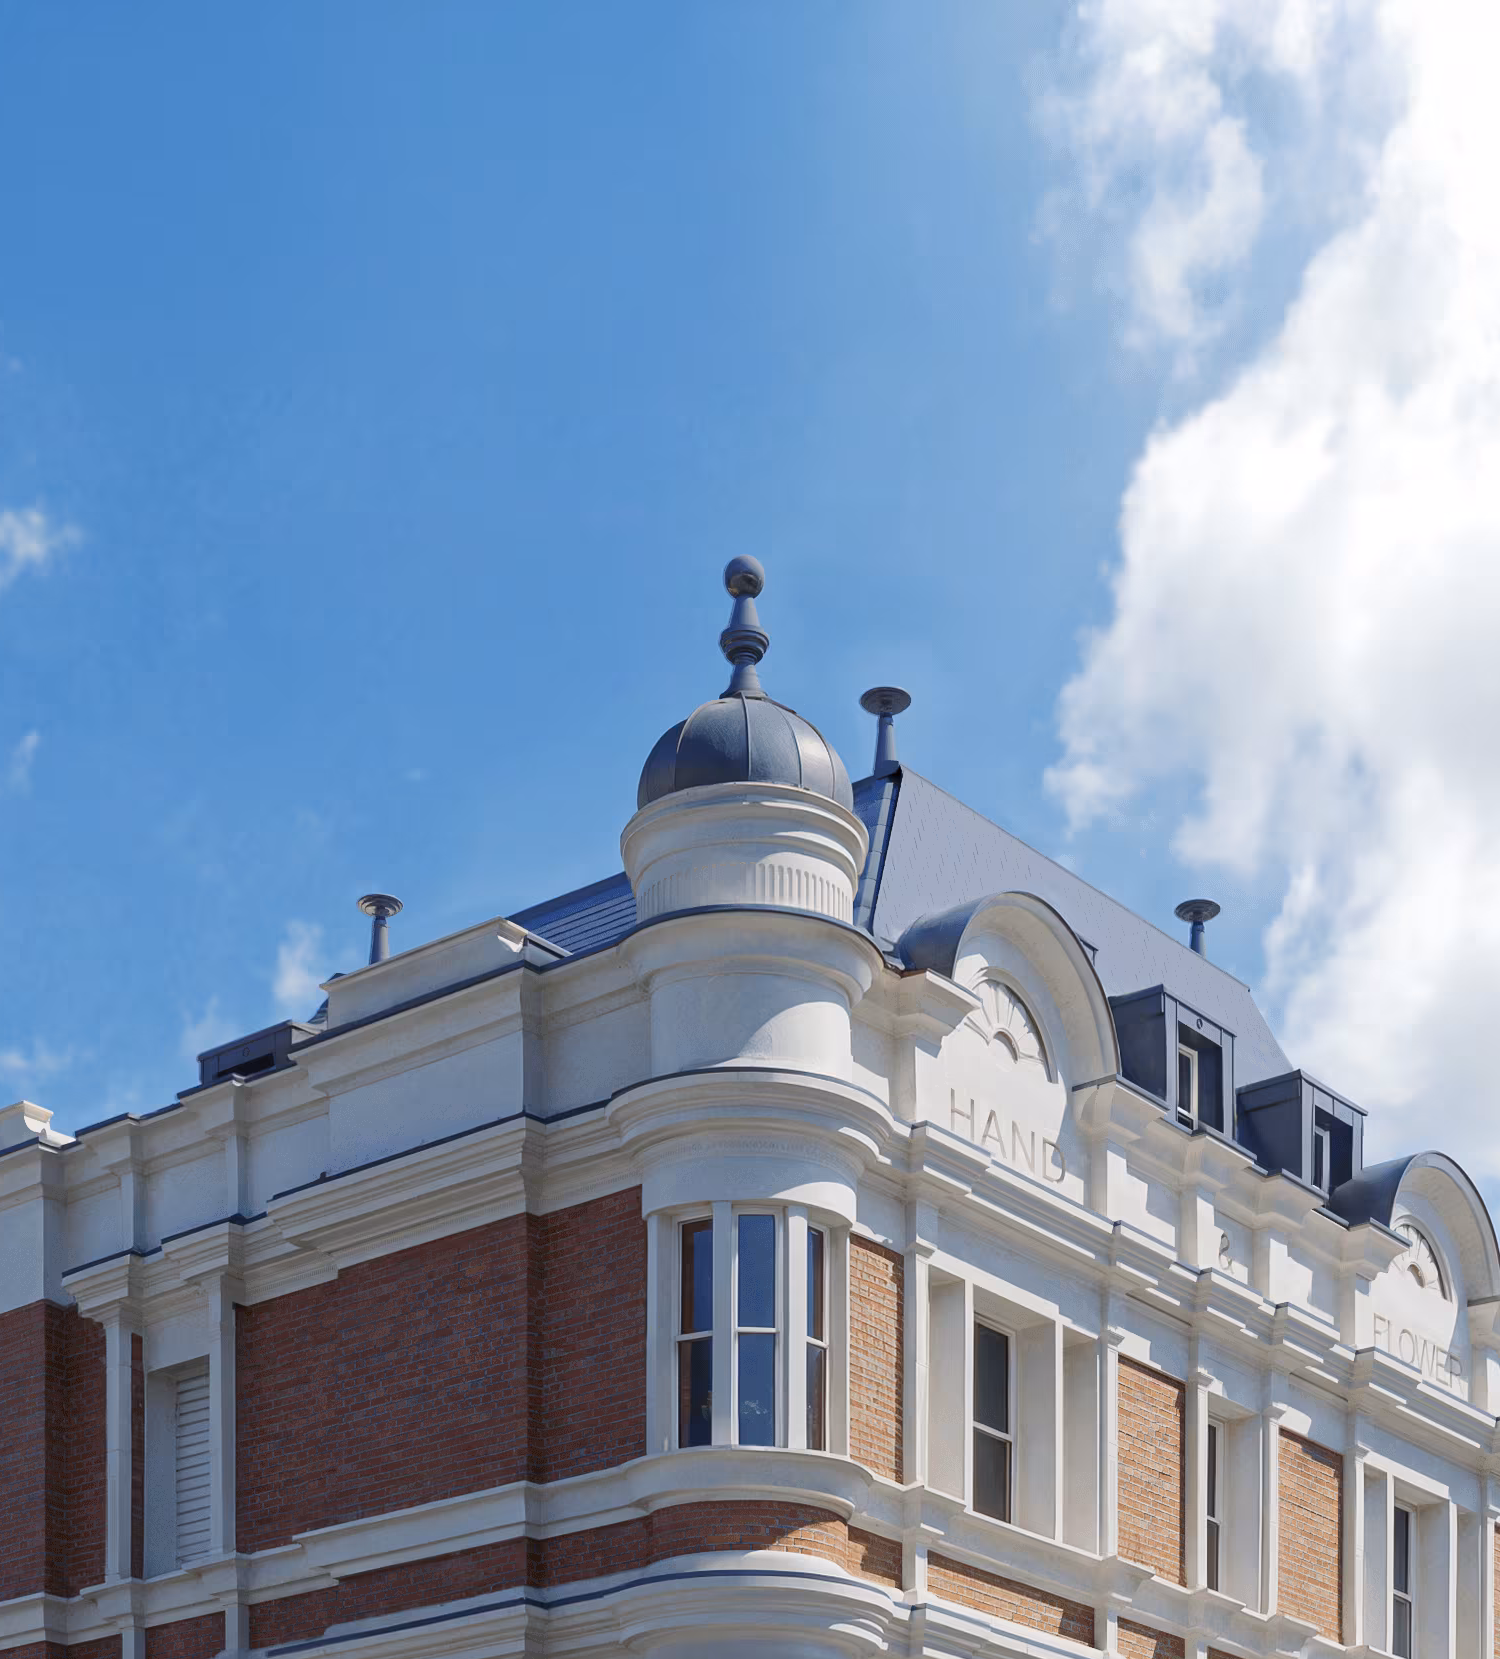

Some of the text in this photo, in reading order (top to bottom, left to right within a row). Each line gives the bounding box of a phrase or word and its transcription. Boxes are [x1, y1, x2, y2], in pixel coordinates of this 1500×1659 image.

[950, 1087, 1466, 1394] HAND & FLOWER
